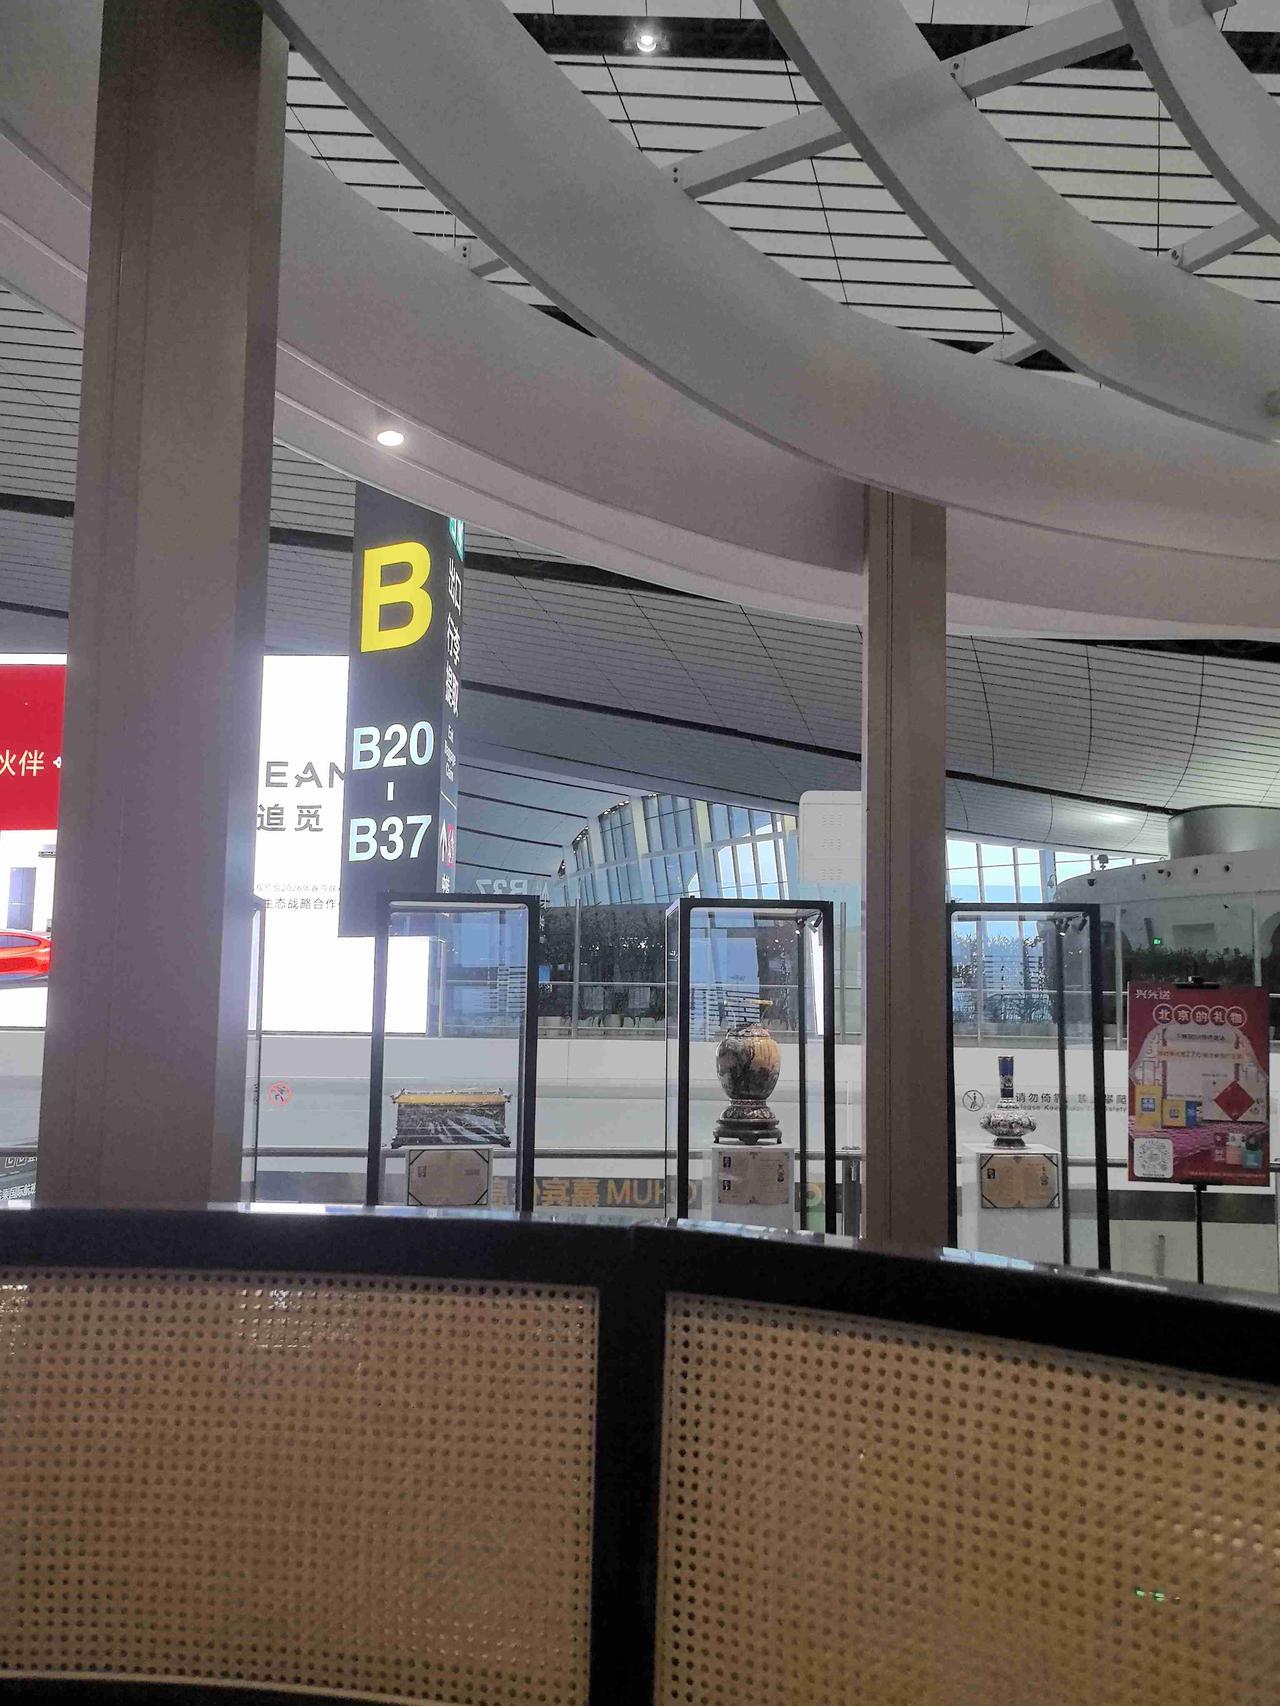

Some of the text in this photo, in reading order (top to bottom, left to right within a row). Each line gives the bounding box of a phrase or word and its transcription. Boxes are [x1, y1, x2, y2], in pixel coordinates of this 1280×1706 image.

[361, 541, 433, 653] B
[352, 721, 434, 770] B20
[349, 815, 433, 861] B37
[1158, 1008, 1242, 1025] 北京的礼物
